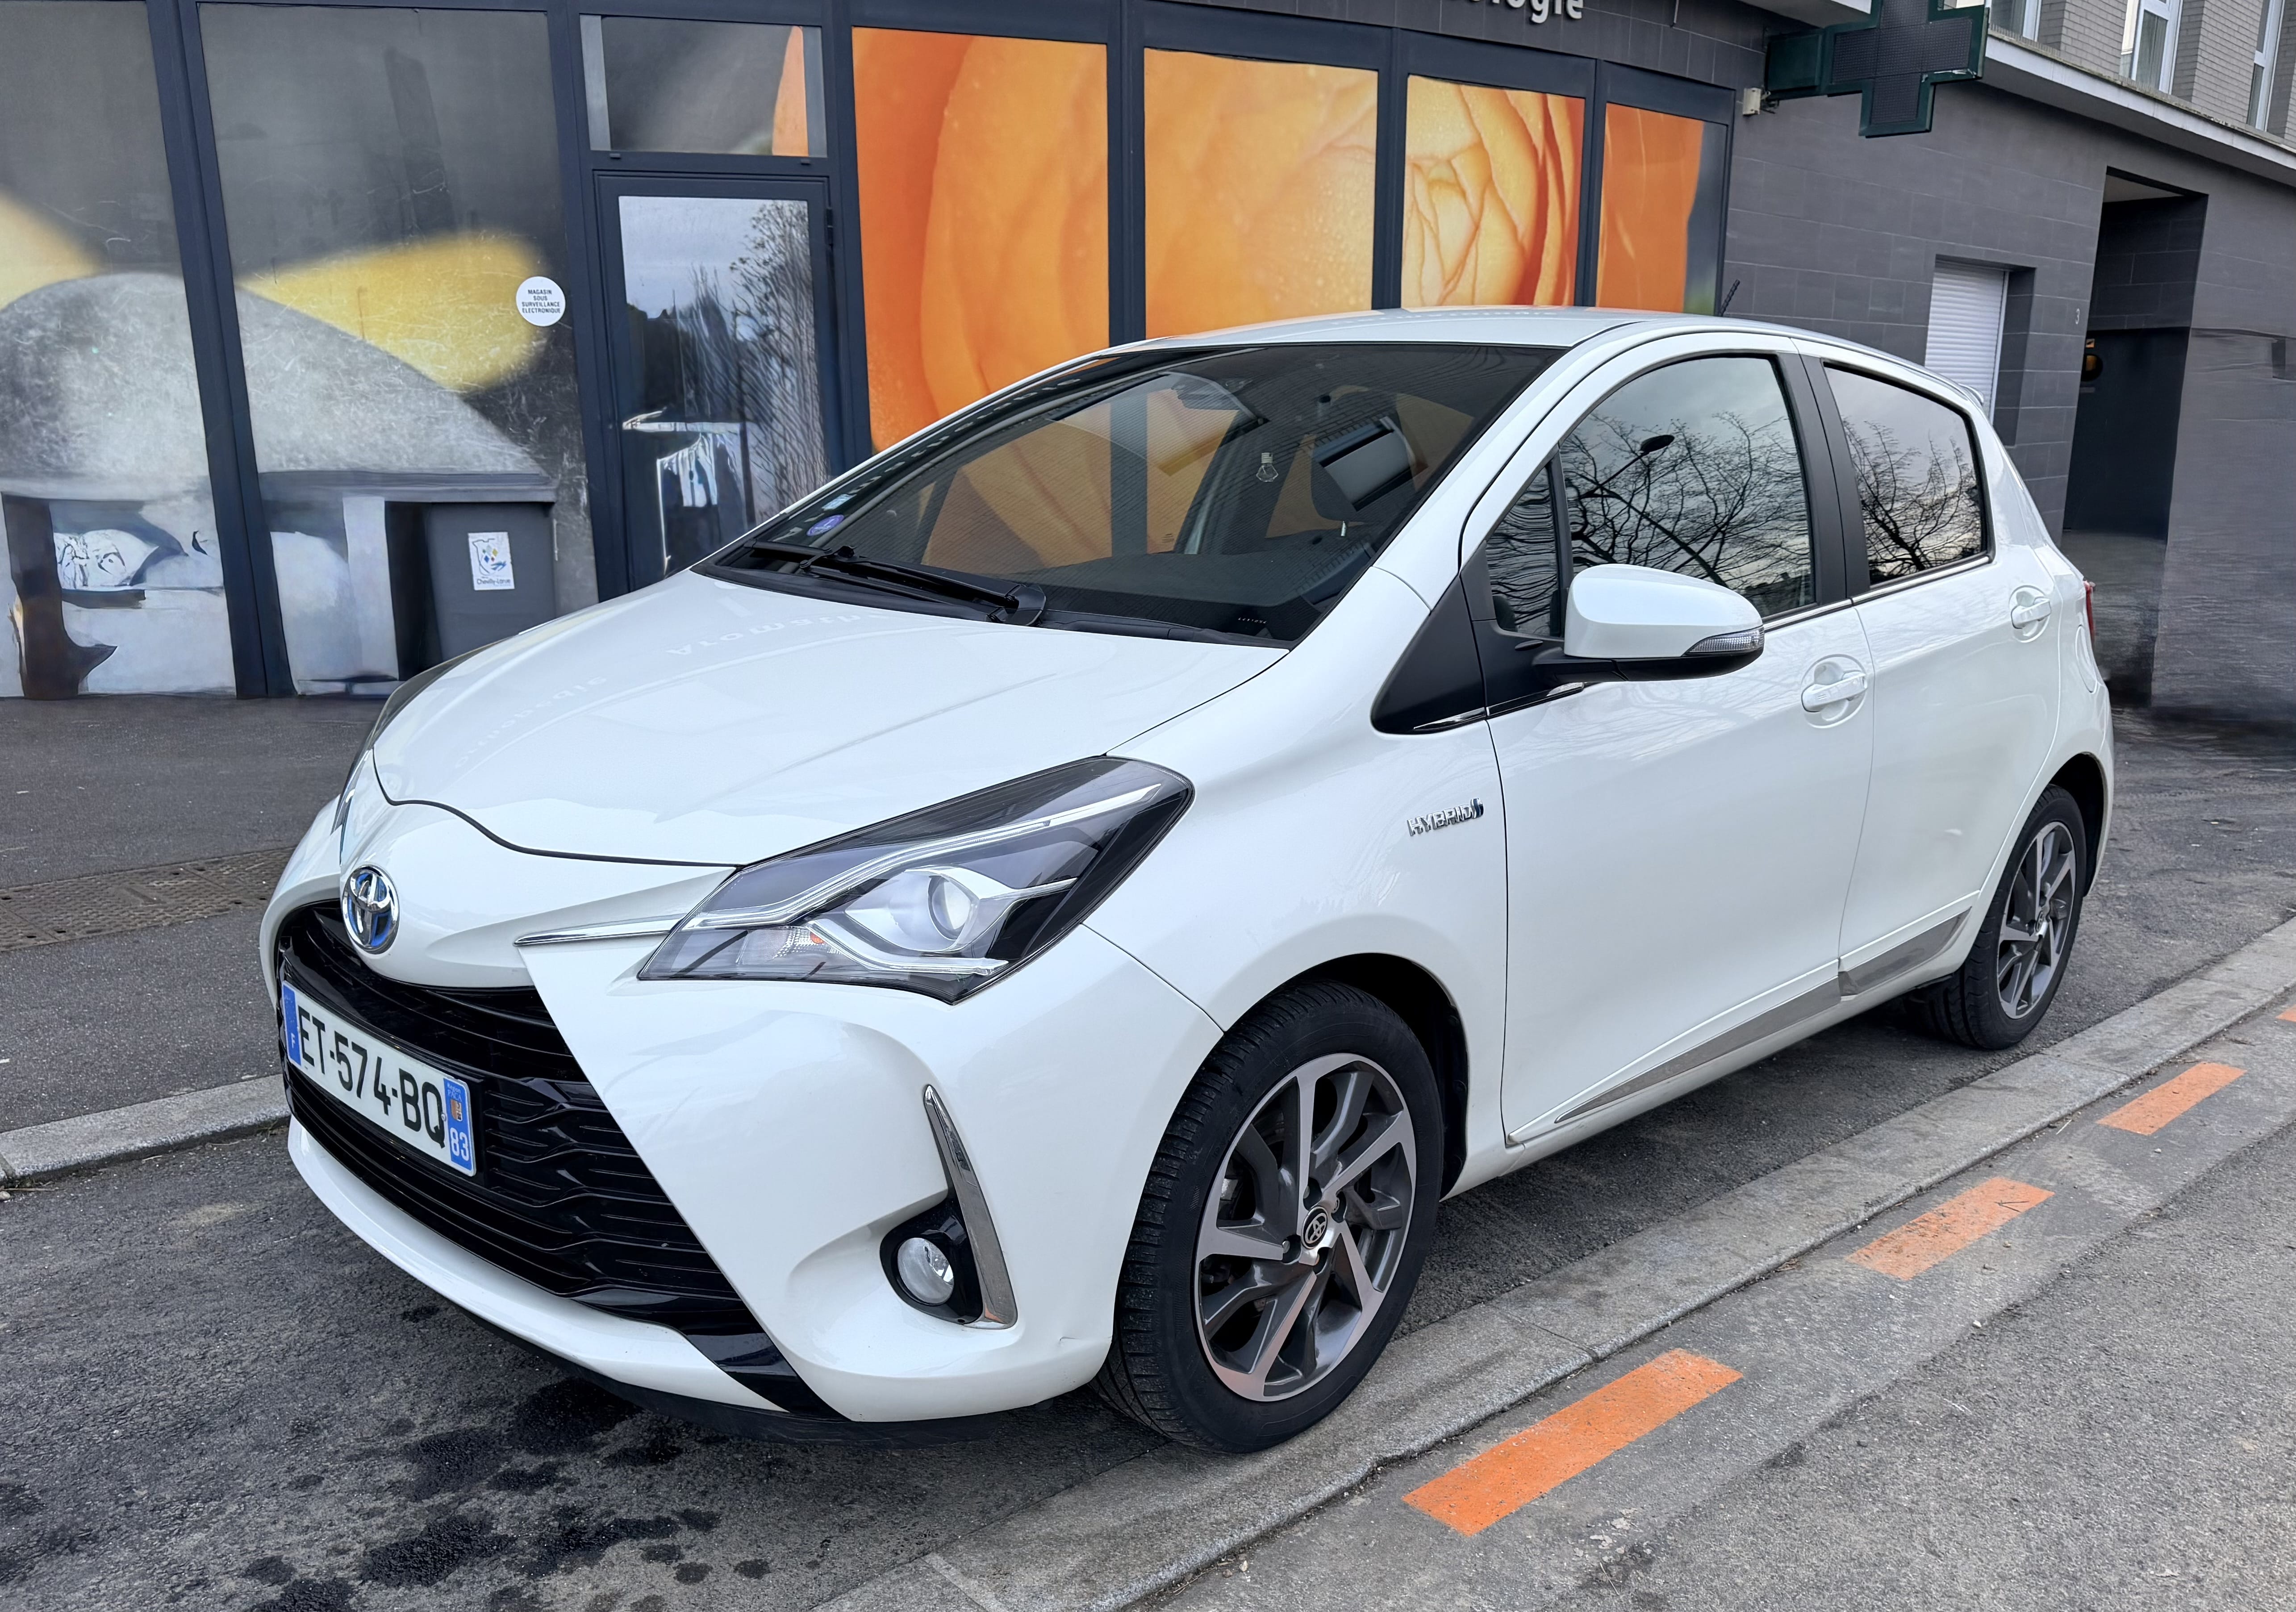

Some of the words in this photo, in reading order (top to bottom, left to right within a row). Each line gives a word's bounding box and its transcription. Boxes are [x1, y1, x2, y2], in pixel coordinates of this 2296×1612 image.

[2075, 308, 2080, 325] 3
[1407, 804, 1473, 836] HYBRID
[291, 1032, 296, 1048] F
[298, 1005, 446, 1149] ET-574-BQ
[449, 1127, 469, 1161] 83
